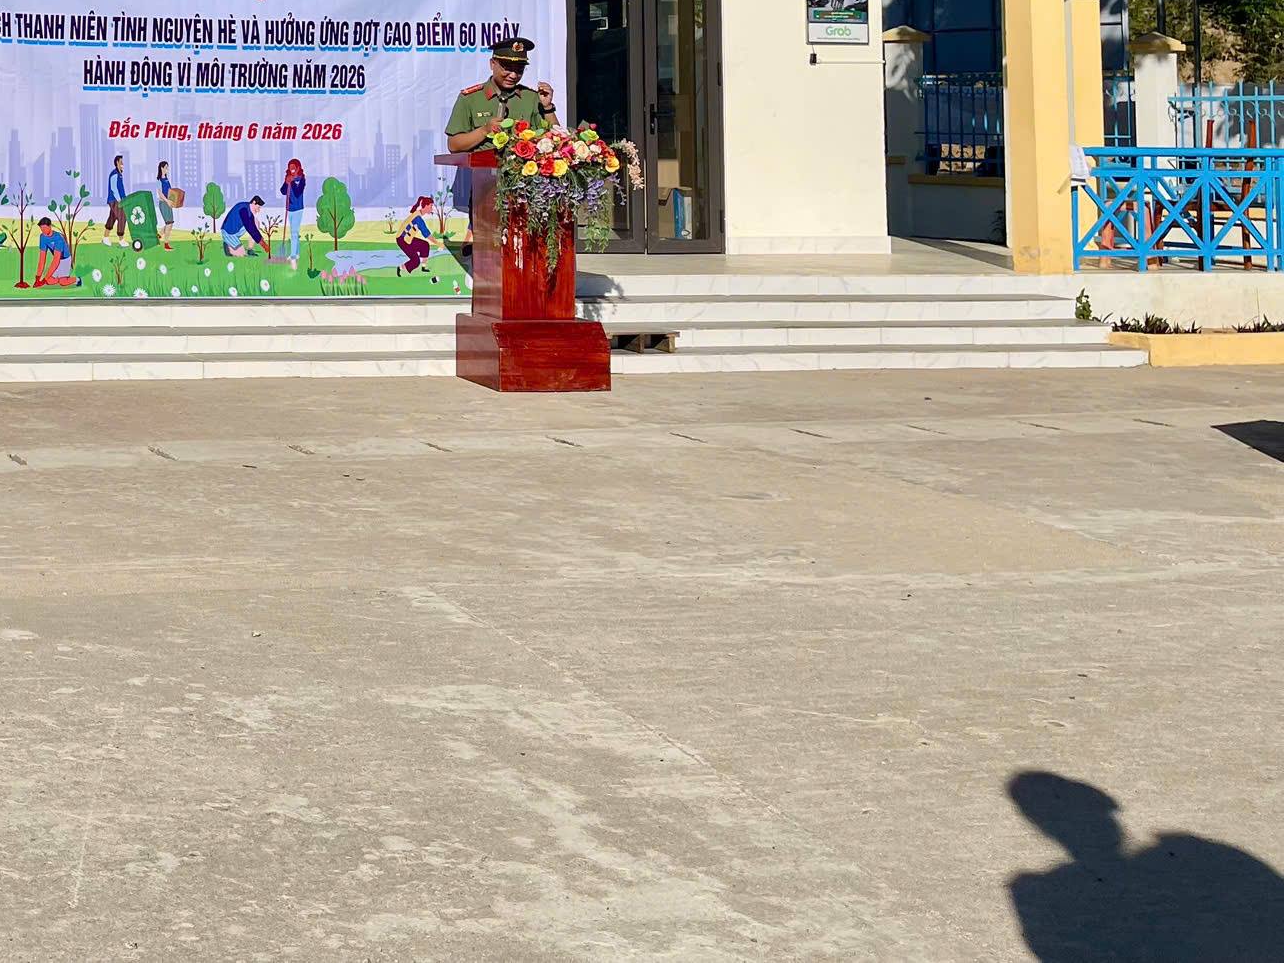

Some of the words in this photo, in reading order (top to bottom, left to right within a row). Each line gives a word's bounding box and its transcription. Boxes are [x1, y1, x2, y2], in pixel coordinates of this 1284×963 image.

[16, 13, 65, 39] THANH
[70, 11, 107, 41] NIÊN
[113, 12, 147, 42] TÌNH
[152, 14, 213, 49] NGUYỆN
[218, 15, 236, 44] HÈ
[242, 15, 260, 45] VÀ
[266, 13, 315, 45] HƯỞNG
[320, 16, 348, 45] ỨNG
[352, 19, 380, 51] ĐỢT
[384, 22, 412, 46] CAO
[416, 13, 454, 46] ĐIỂM
[459, 22, 476, 47] 60
[482, 17, 520, 46] NGÀY
[826, 26, 851, 36] Grab
[83, 56, 125, 85] HÀNH
[130, 57, 172, 91] ĐỘNG
[178, 59, 192, 86] VÌ
[196, 59, 225, 87] MÔI
[229, 58, 288, 88] TRƯỜNG
[292, 59, 326, 88] NĂM
[330, 65, 366, 89] 2026
[109, 117, 140, 138] Đắc
[145, 121, 192, 141] Pring,
[197, 121, 246, 141] tháng
[247, 123, 258, 139] 6
[262, 122, 298, 139] năm
[301, 124, 342, 140] 2026
